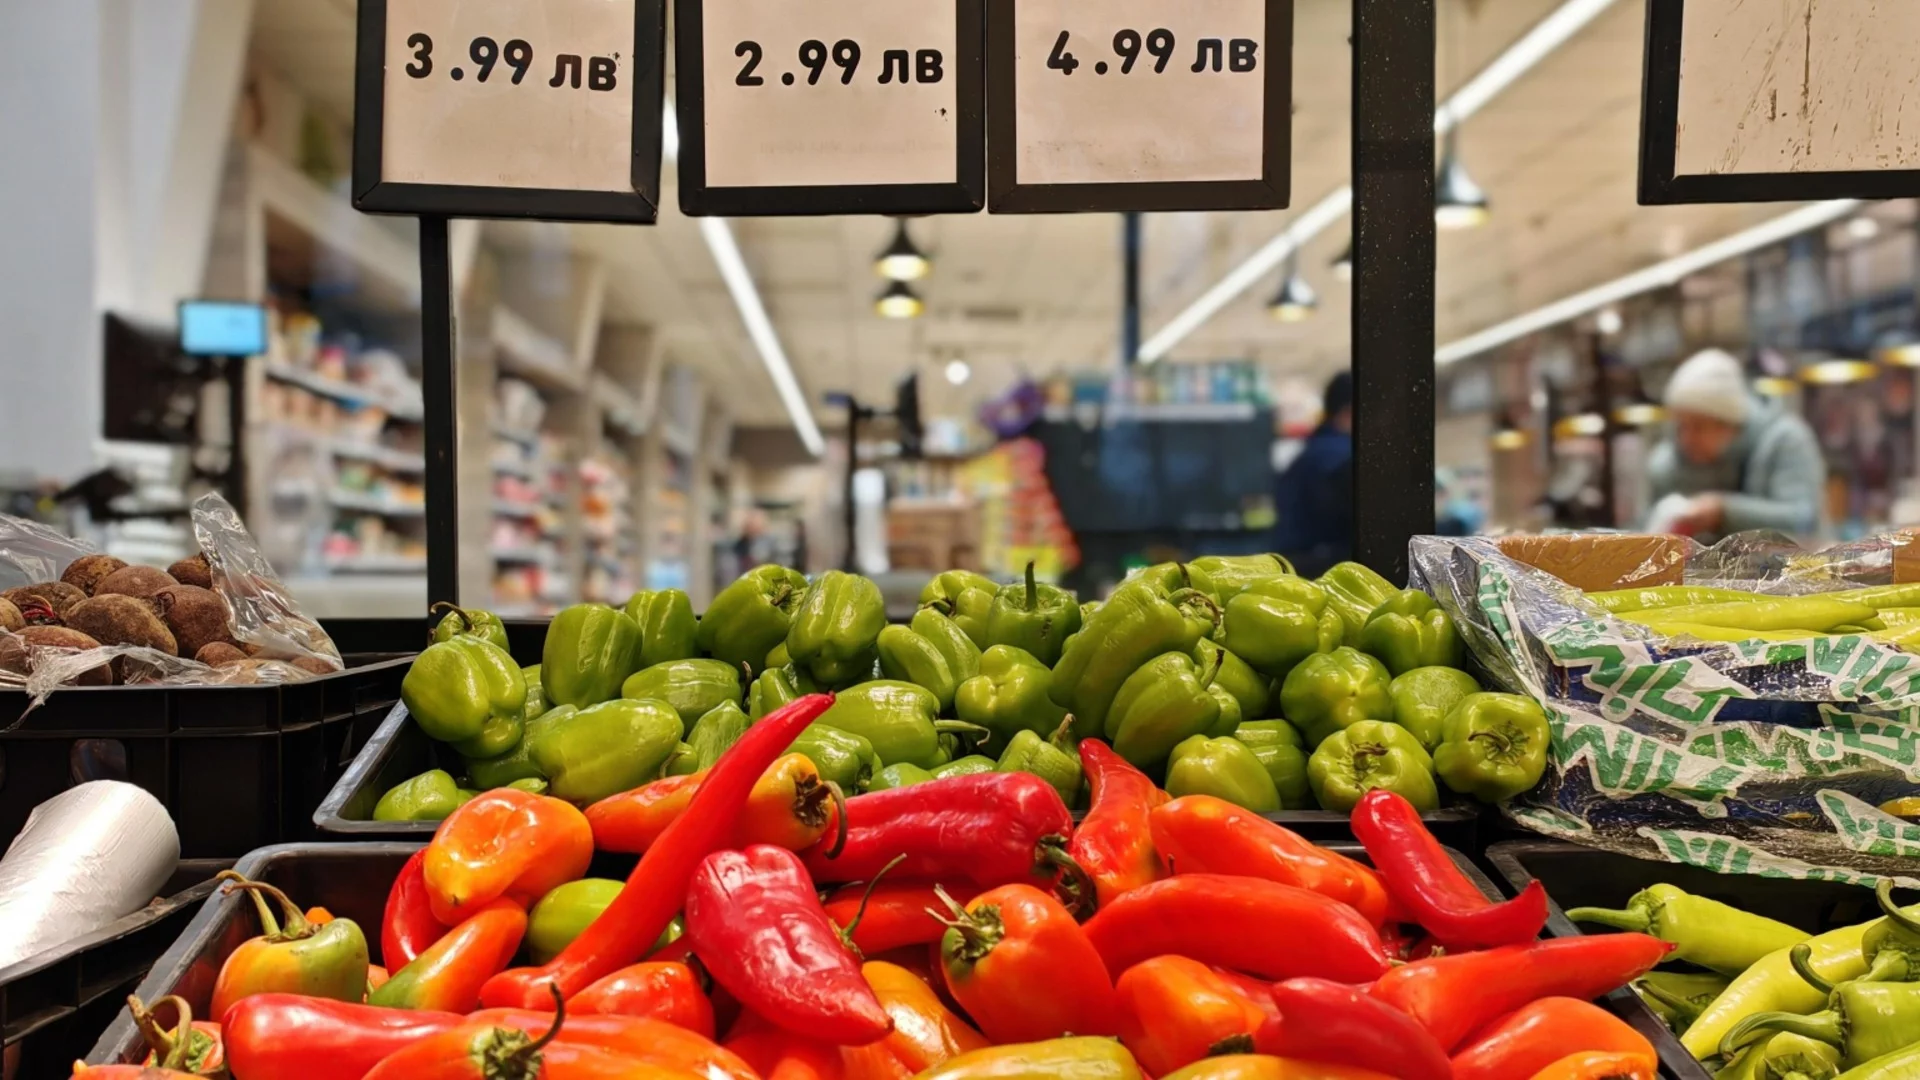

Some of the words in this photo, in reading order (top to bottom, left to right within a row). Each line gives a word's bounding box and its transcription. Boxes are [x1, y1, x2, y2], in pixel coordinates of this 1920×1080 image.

[549, 55, 616, 91] лв
[878, 50, 943, 84] лв
[1191, 39, 1257, 73] лв
